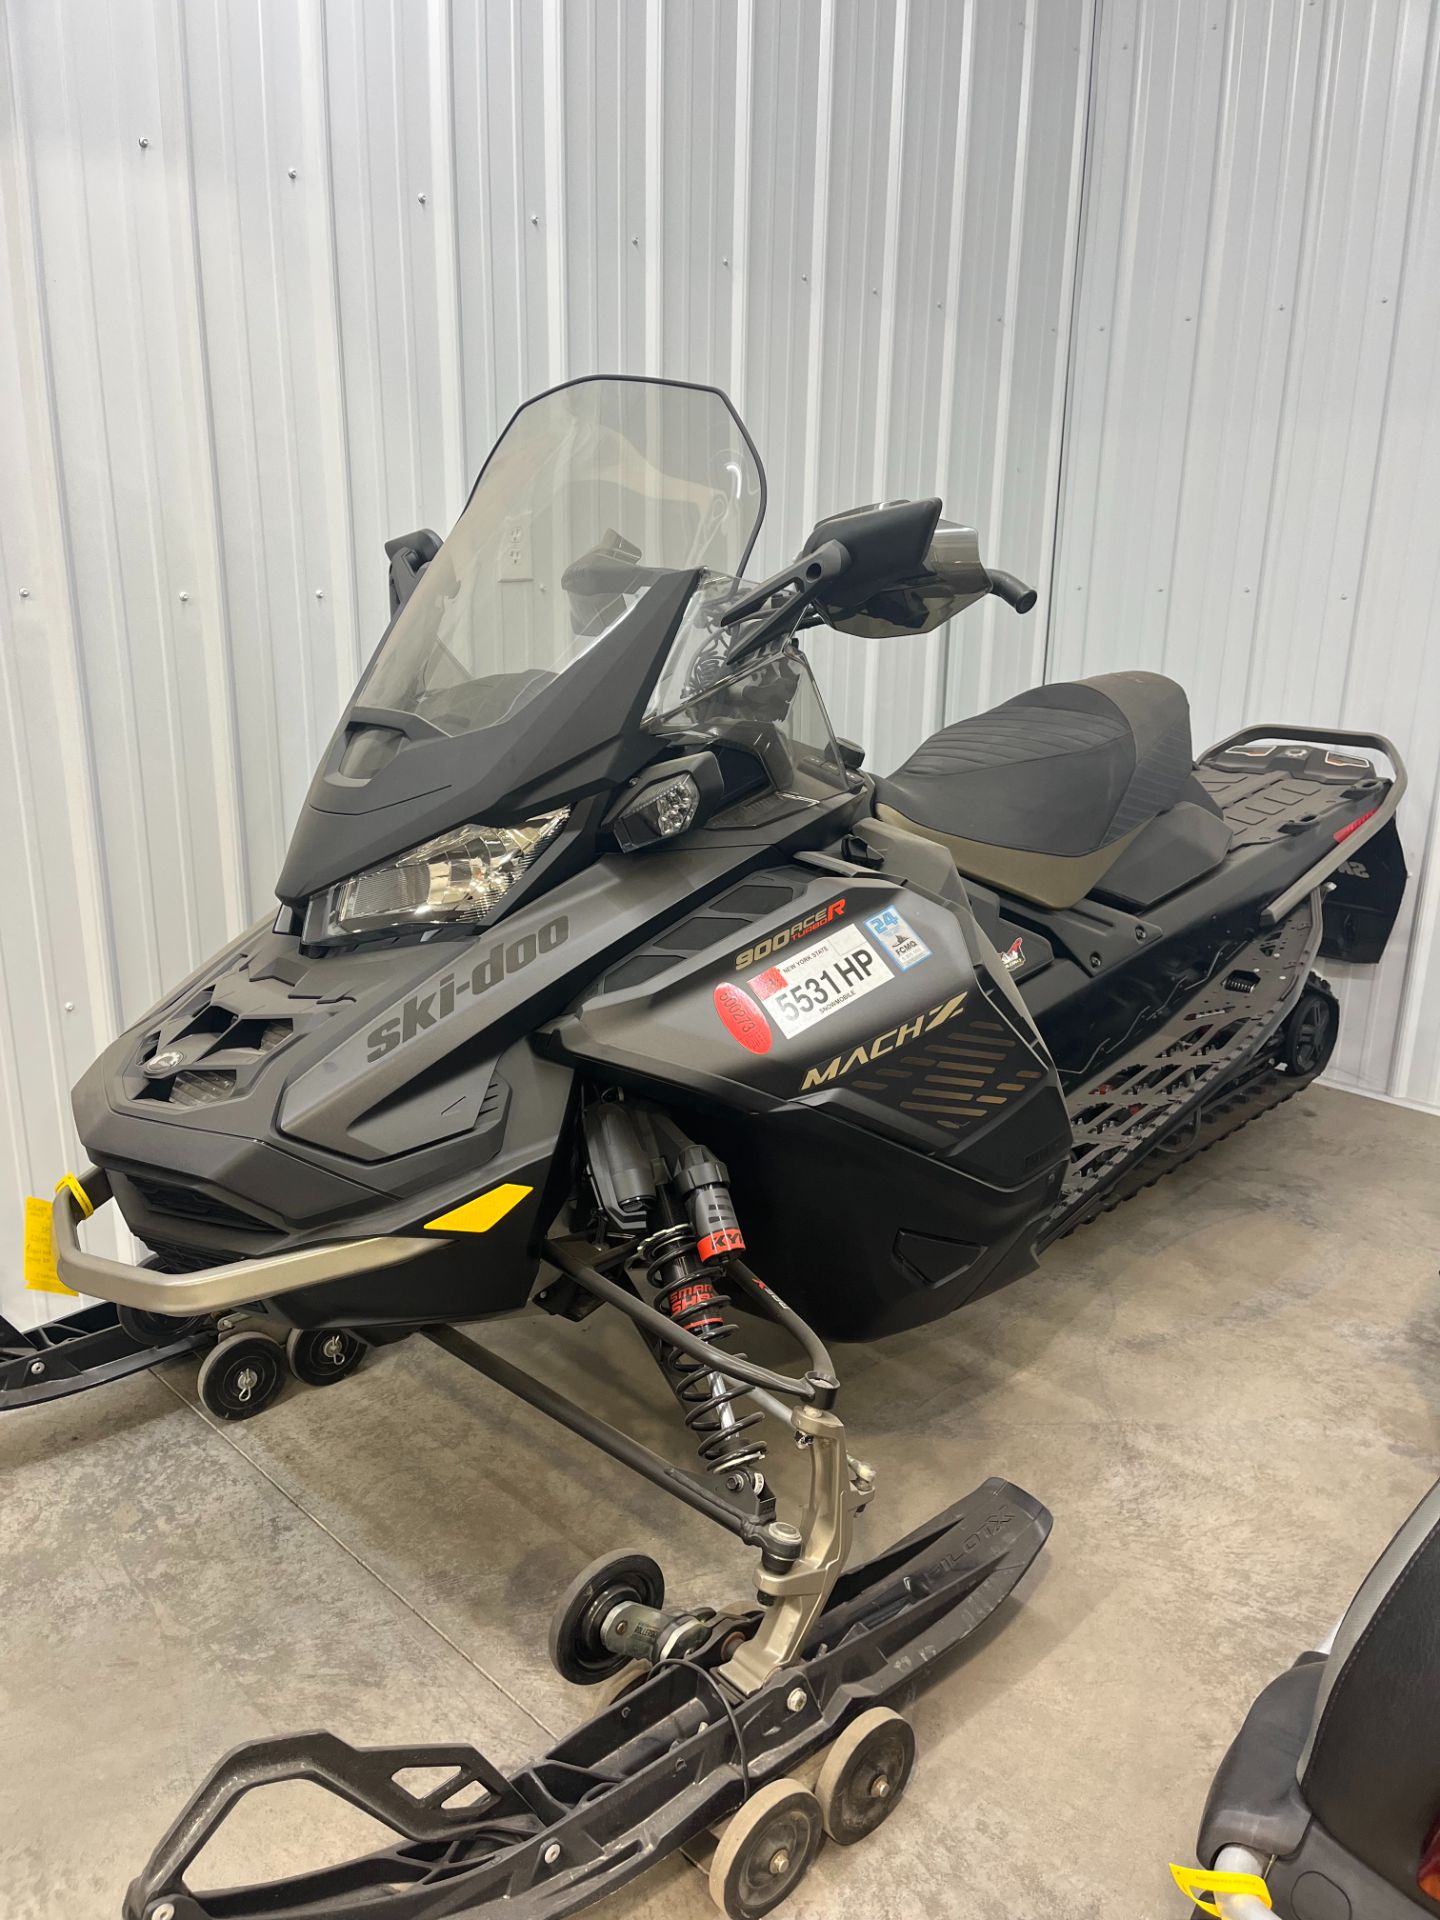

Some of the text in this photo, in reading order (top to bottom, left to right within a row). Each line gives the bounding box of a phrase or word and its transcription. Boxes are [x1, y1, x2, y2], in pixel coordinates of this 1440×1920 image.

[870, 911, 898, 934] 24
[735, 929, 790, 971] 900
[791, 908, 827, 936] ACE
[782, 945, 829, 974] NEW YORK STATE
[367, 915, 569, 1063] ski-doo
[775, 948, 873, 1021] 5531 HP
[818, 989, 856, 1014] SNOWMOBILE
[711, 1232, 744, 1250] KY
